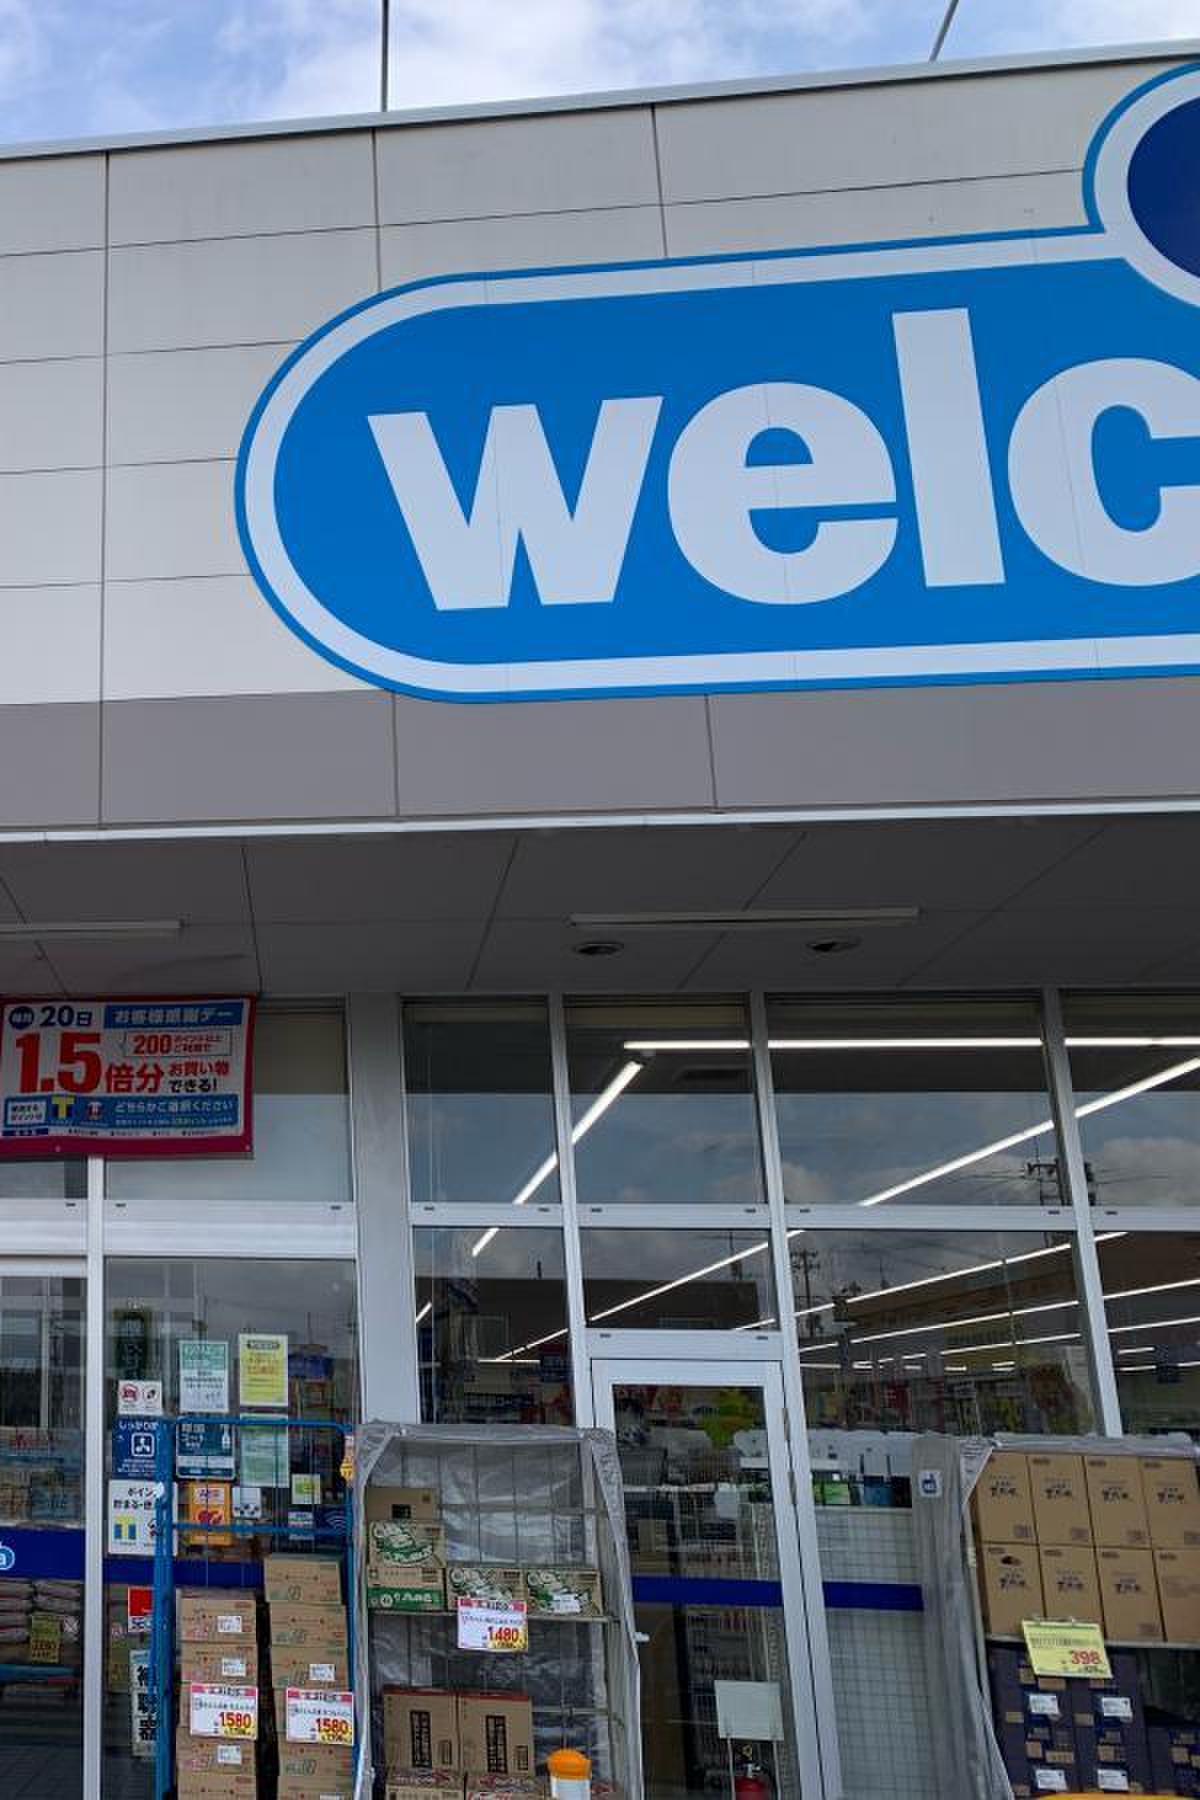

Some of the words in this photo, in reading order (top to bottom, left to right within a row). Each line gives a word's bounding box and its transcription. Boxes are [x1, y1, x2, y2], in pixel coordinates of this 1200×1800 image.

[367, 307, 1200, 611] welc
[40, 1006, 92, 1027] 20日
[133, 1034, 173, 1055] 200
[168, 1061, 230, 1076] お買い物
[128, 1487, 155, 1497] ポイン
[1071, 1650, 1102, 1665] 398
[219, 1711, 252, 1729] 1580
[316, 1717, 349, 1735] 1580
